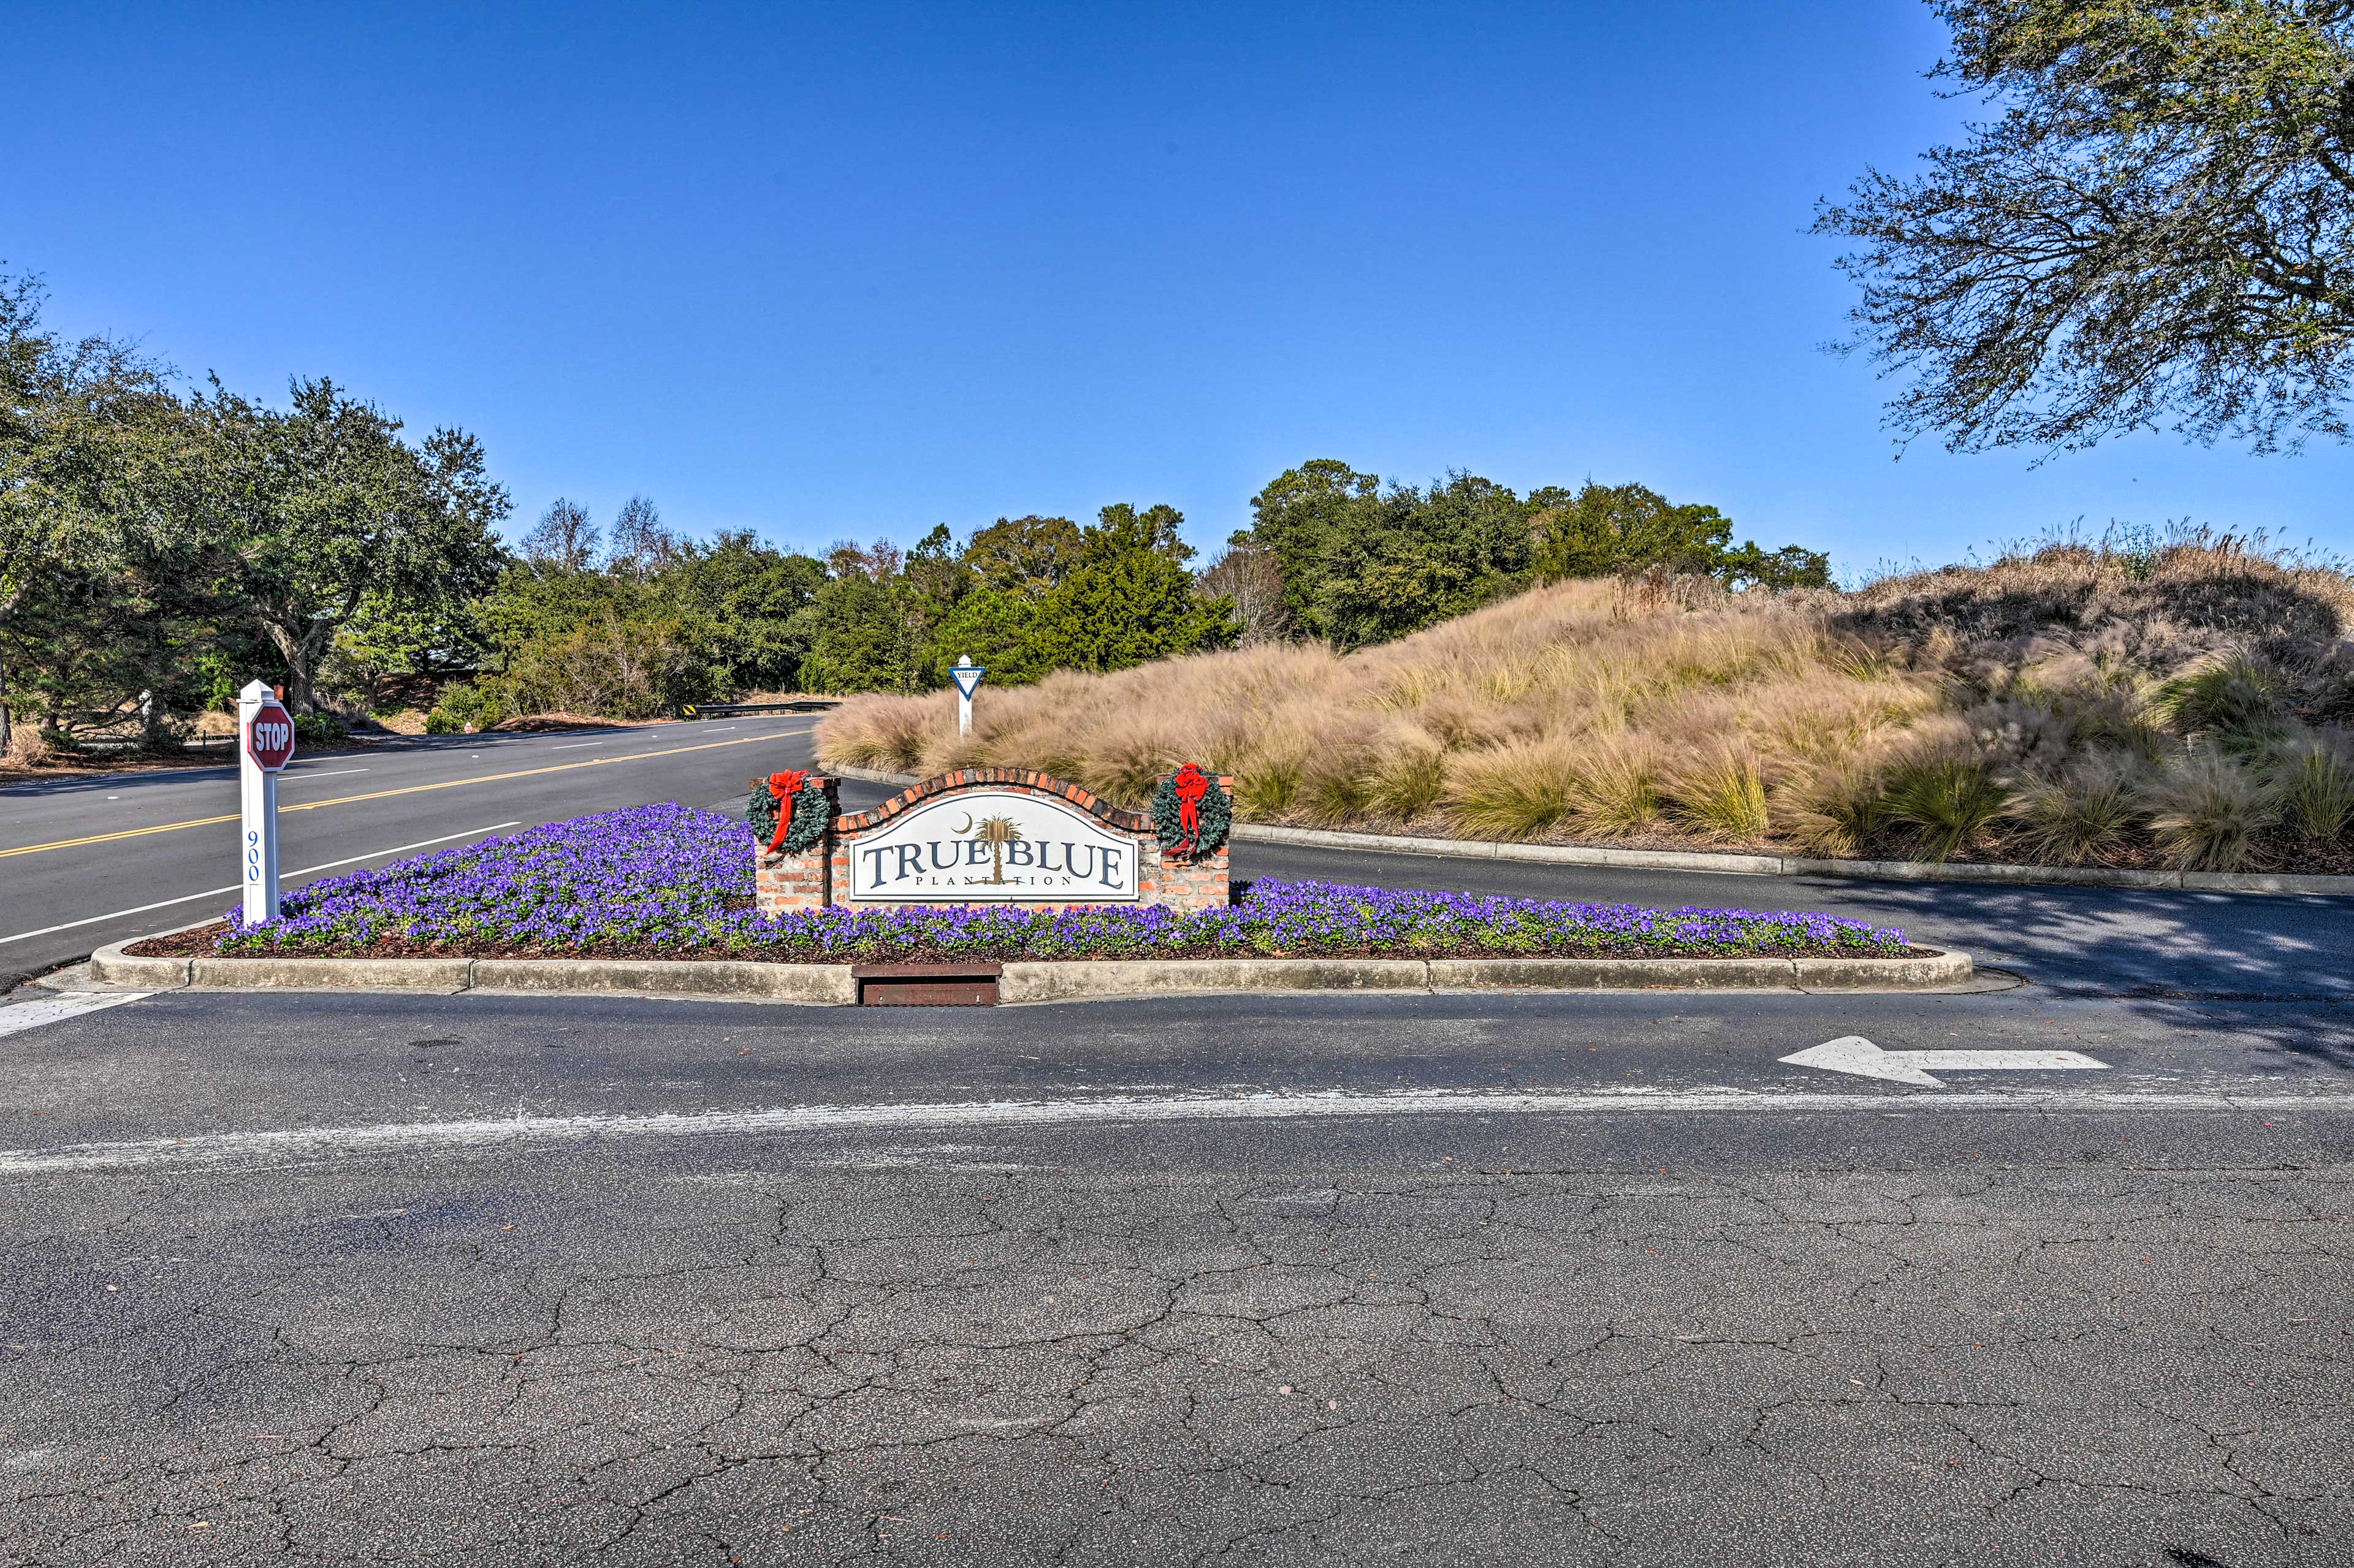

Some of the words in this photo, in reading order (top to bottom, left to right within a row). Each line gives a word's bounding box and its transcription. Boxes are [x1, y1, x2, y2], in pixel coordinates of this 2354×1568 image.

[256, 722, 289, 752] STOP
[248, 831, 259, 881] 900
[863, 840, 991, 889] TRUE
[1004, 840, 1124, 889] BLUE
[916, 877, 1071, 885] PLANTATION
